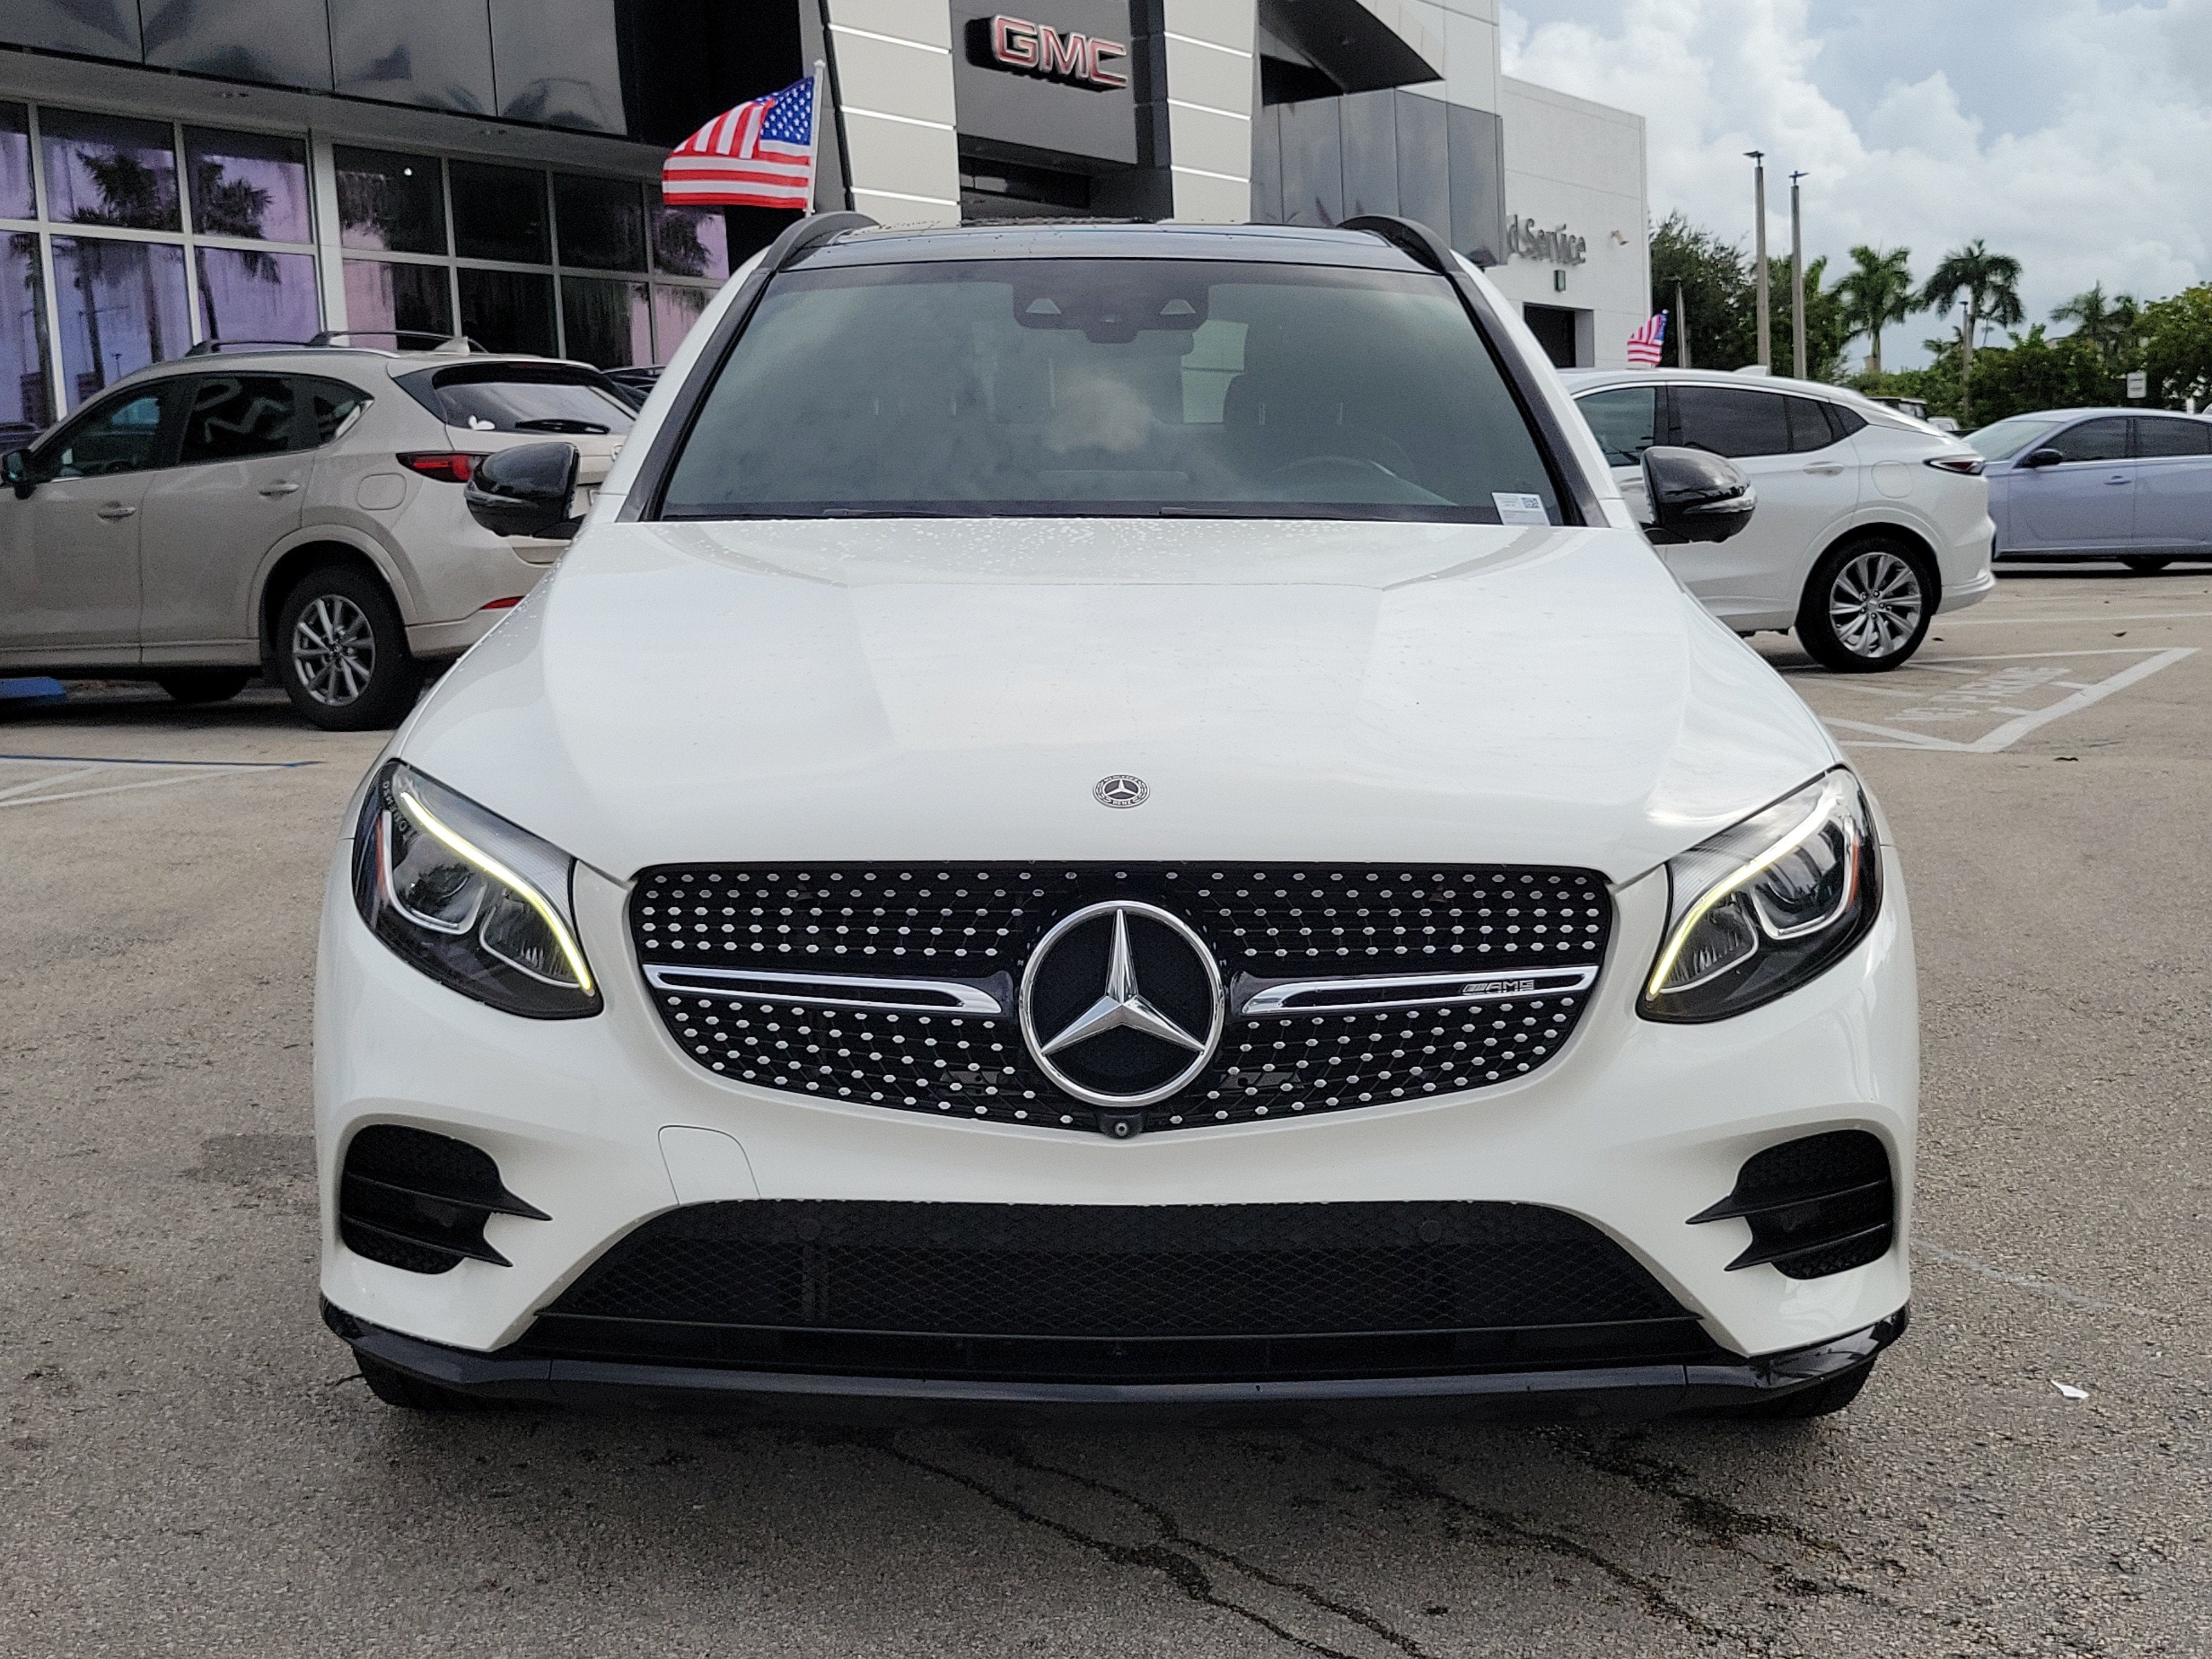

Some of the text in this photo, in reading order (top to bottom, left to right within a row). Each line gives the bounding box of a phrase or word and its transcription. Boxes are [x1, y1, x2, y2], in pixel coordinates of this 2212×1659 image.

[991, 14, 1127, 88] GMC
[1519, 218, 1586, 266] Service
[1486, 979, 1535, 992] AMG
